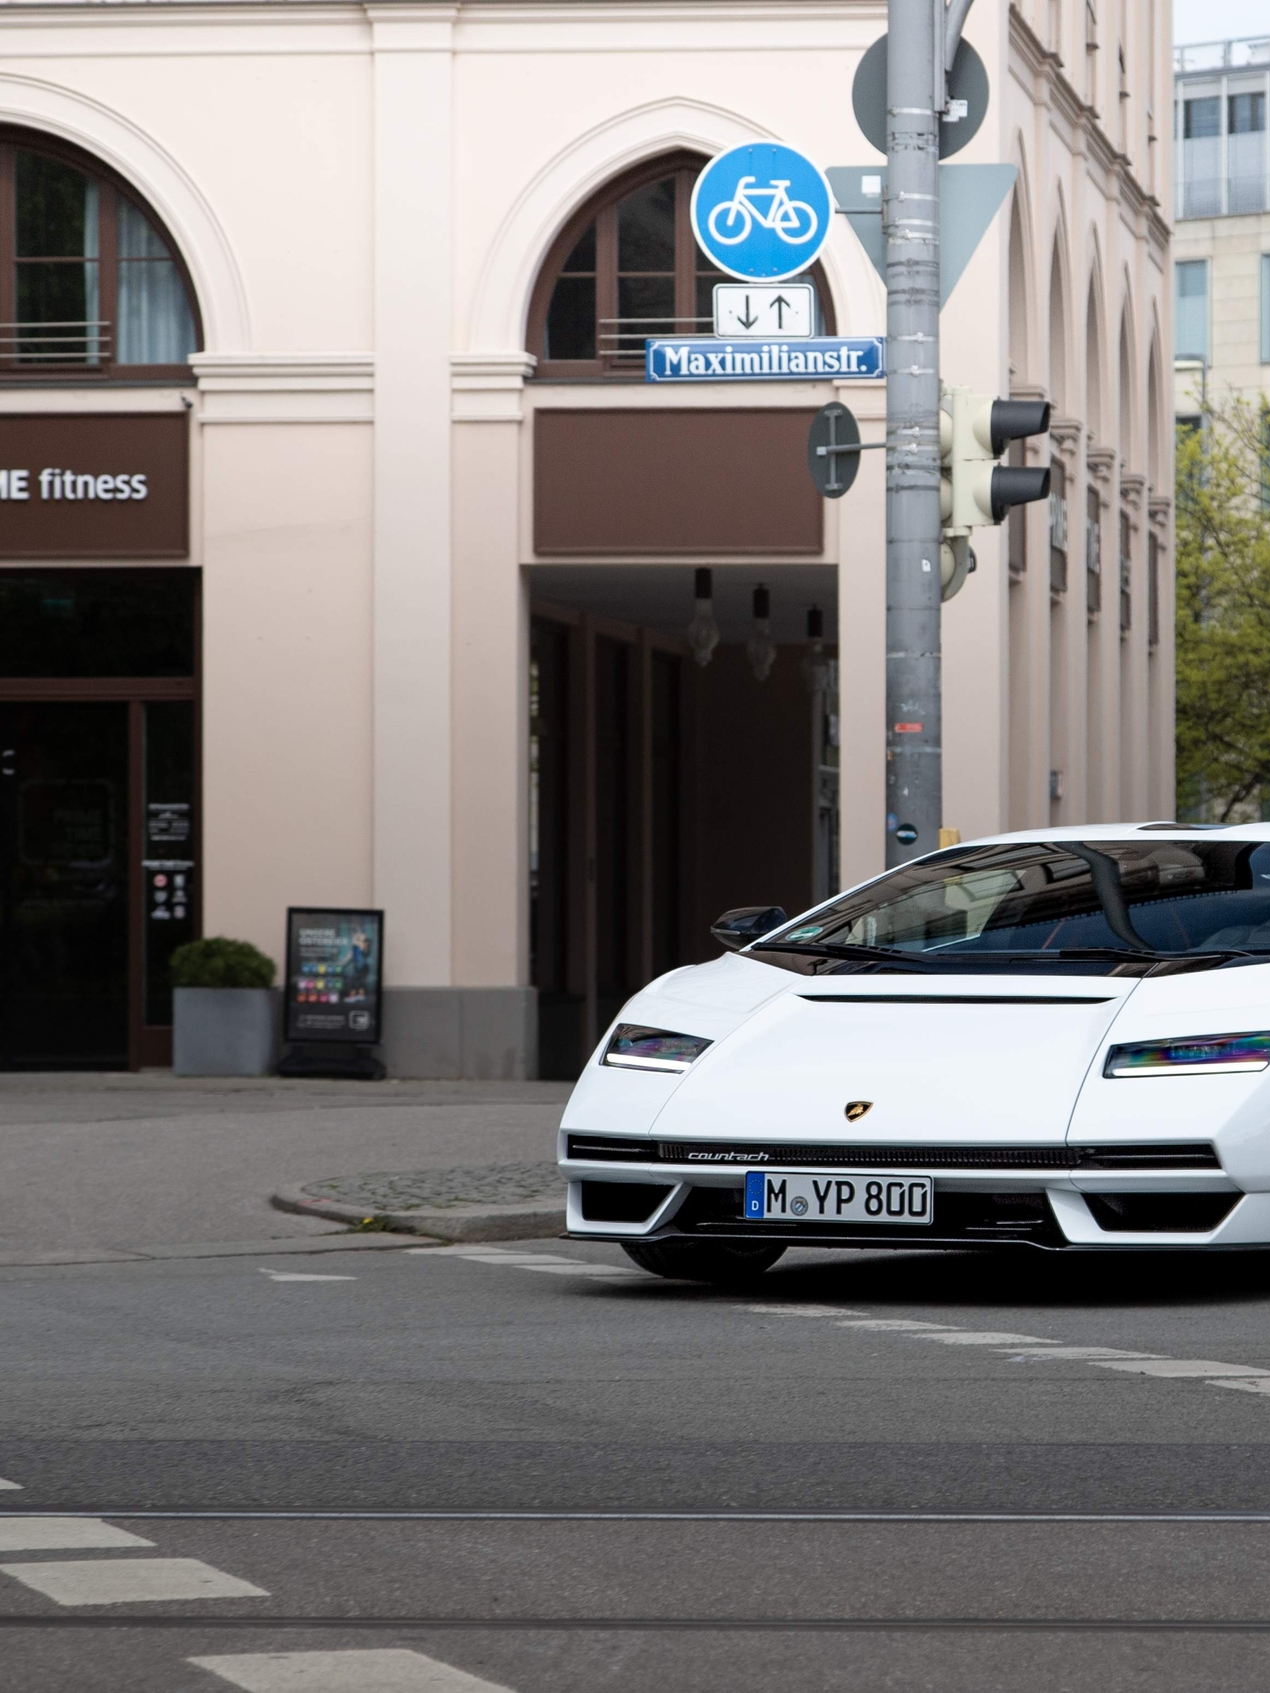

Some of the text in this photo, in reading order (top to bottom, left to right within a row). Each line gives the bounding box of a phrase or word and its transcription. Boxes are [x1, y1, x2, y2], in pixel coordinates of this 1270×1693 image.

[664, 345, 868, 376] Maximilianstr.
[0, 467, 149, 500] E fitness
[687, 1151, 769, 1161] countach
[751, 1200, 759, 1211] D
[767, 1179, 928, 1217] M YP 800
